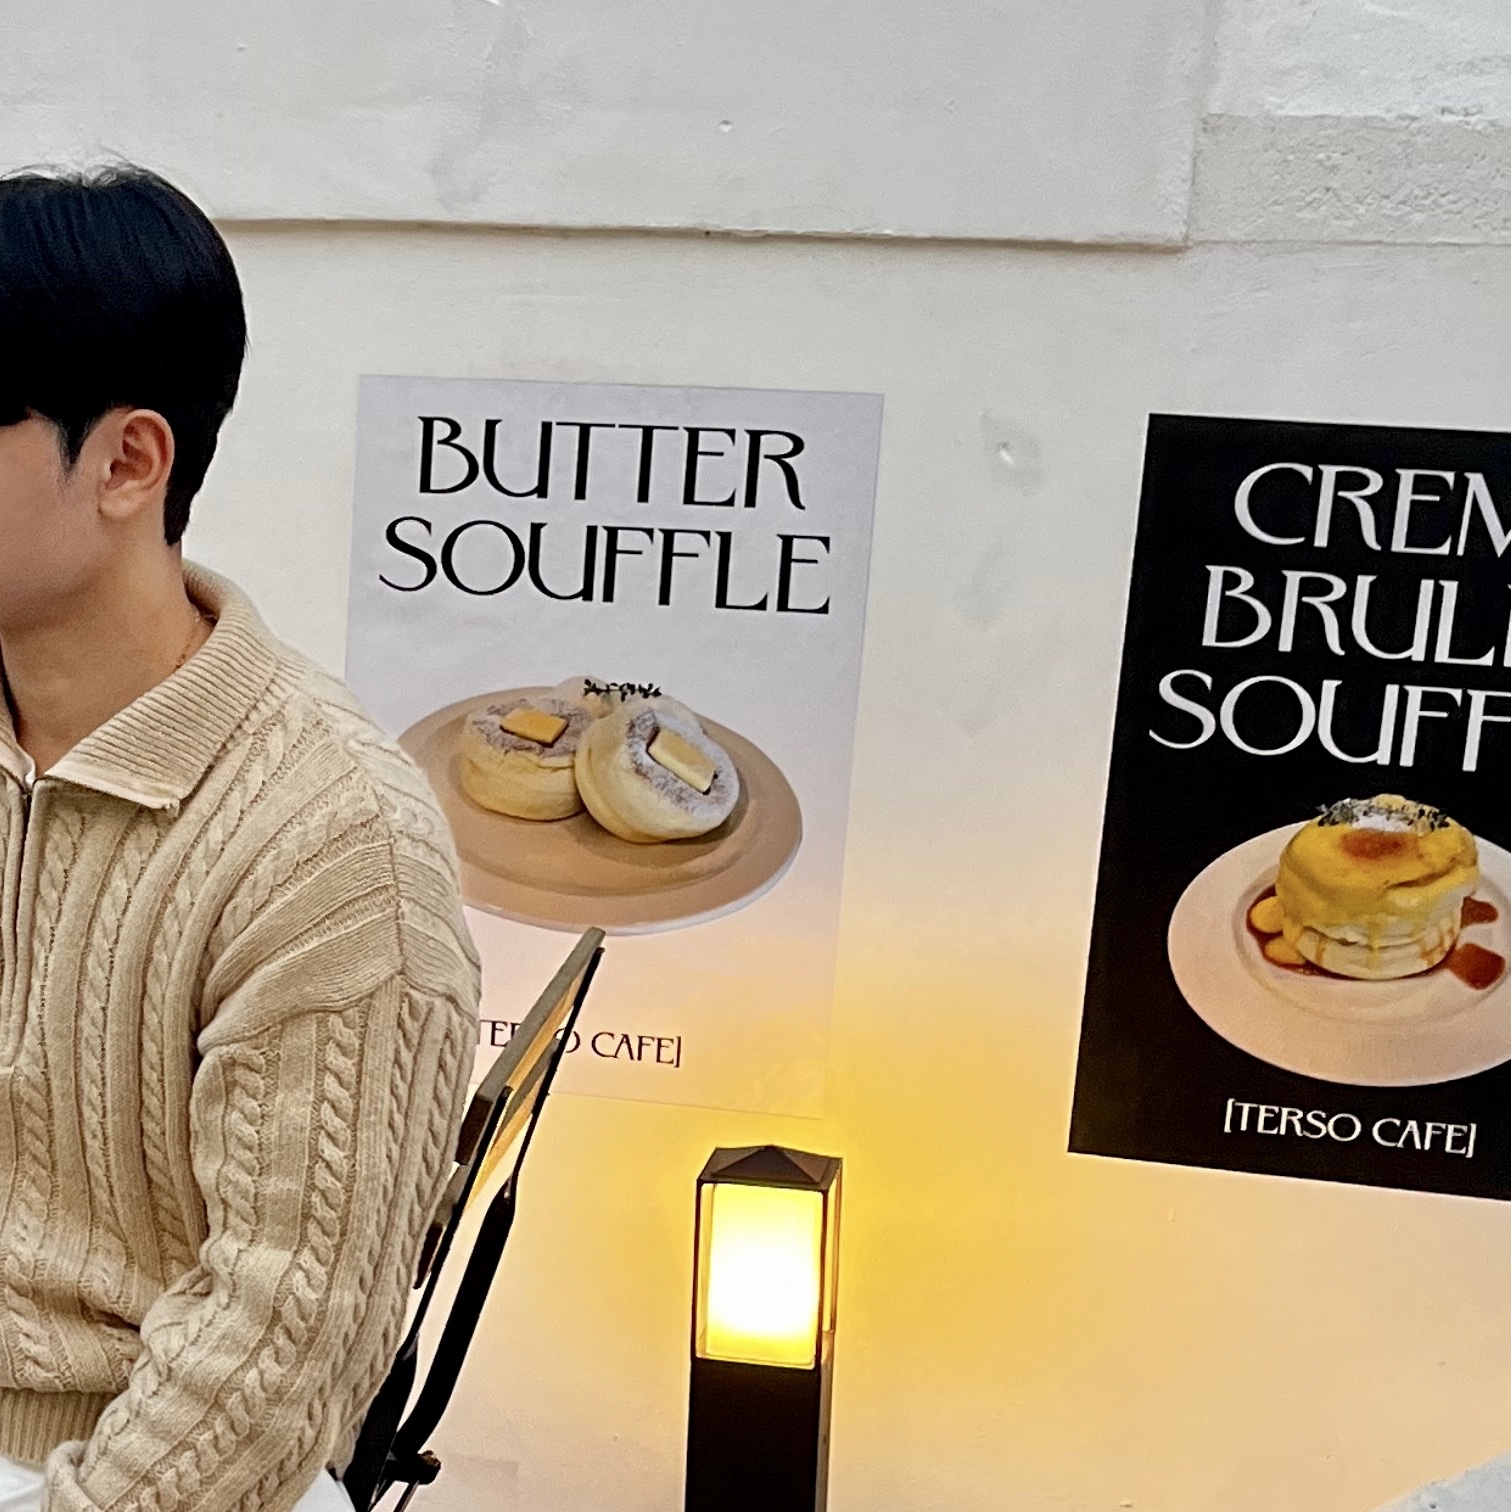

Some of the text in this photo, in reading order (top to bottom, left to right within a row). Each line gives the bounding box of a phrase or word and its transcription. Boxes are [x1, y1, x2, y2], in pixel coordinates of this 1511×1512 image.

[417, 415, 806, 511] BUTTER
[379, 515, 831, 615] SOUFFLE
[1201, 564, 1511, 668] BRUL
[591, 1031, 682, 1069] CAFE]
[1223, 1098, 1477, 1159] [TERSO CAFE]
